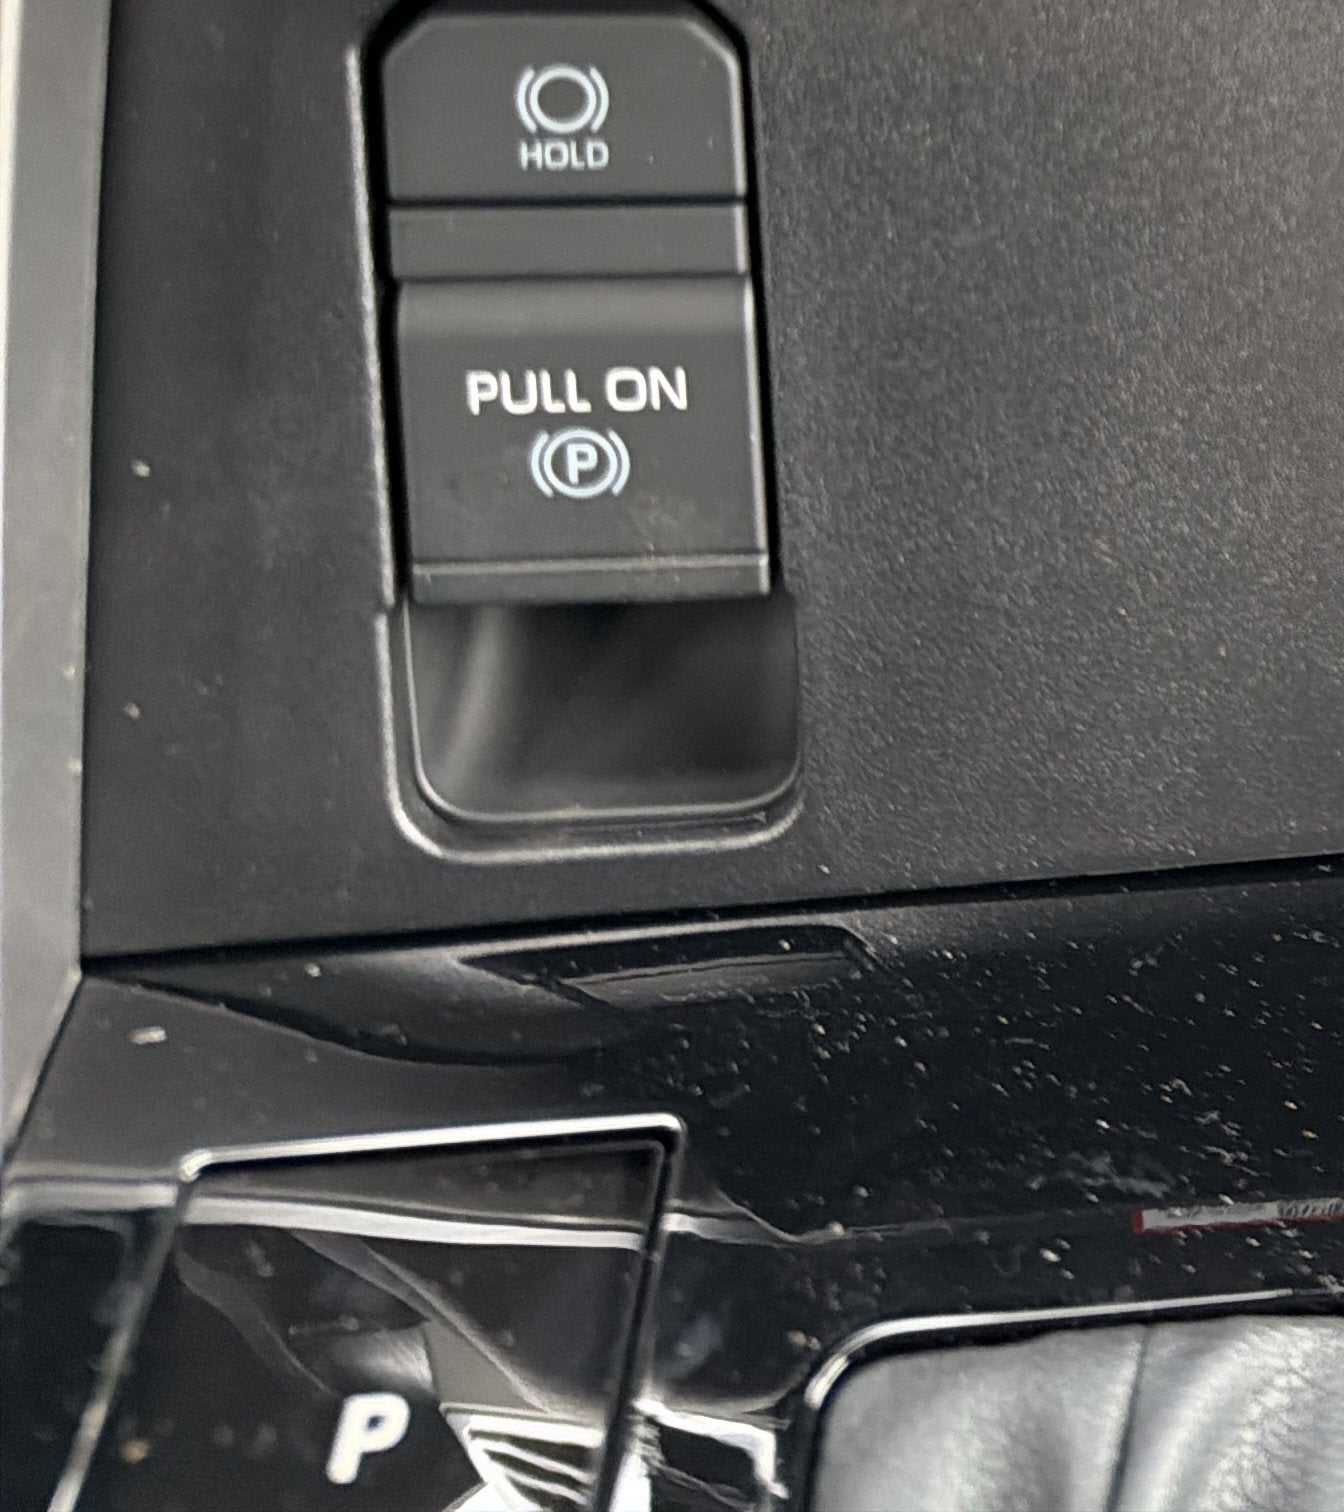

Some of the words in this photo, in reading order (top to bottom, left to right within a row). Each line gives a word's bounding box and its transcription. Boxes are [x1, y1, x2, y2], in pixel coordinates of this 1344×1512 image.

[518, 140, 610, 171] HOLD
[466, 368, 591, 415] PULL
[606, 365, 688, 411] ON
[566, 443, 598, 485] P
[325, 1391, 410, 1485] P
